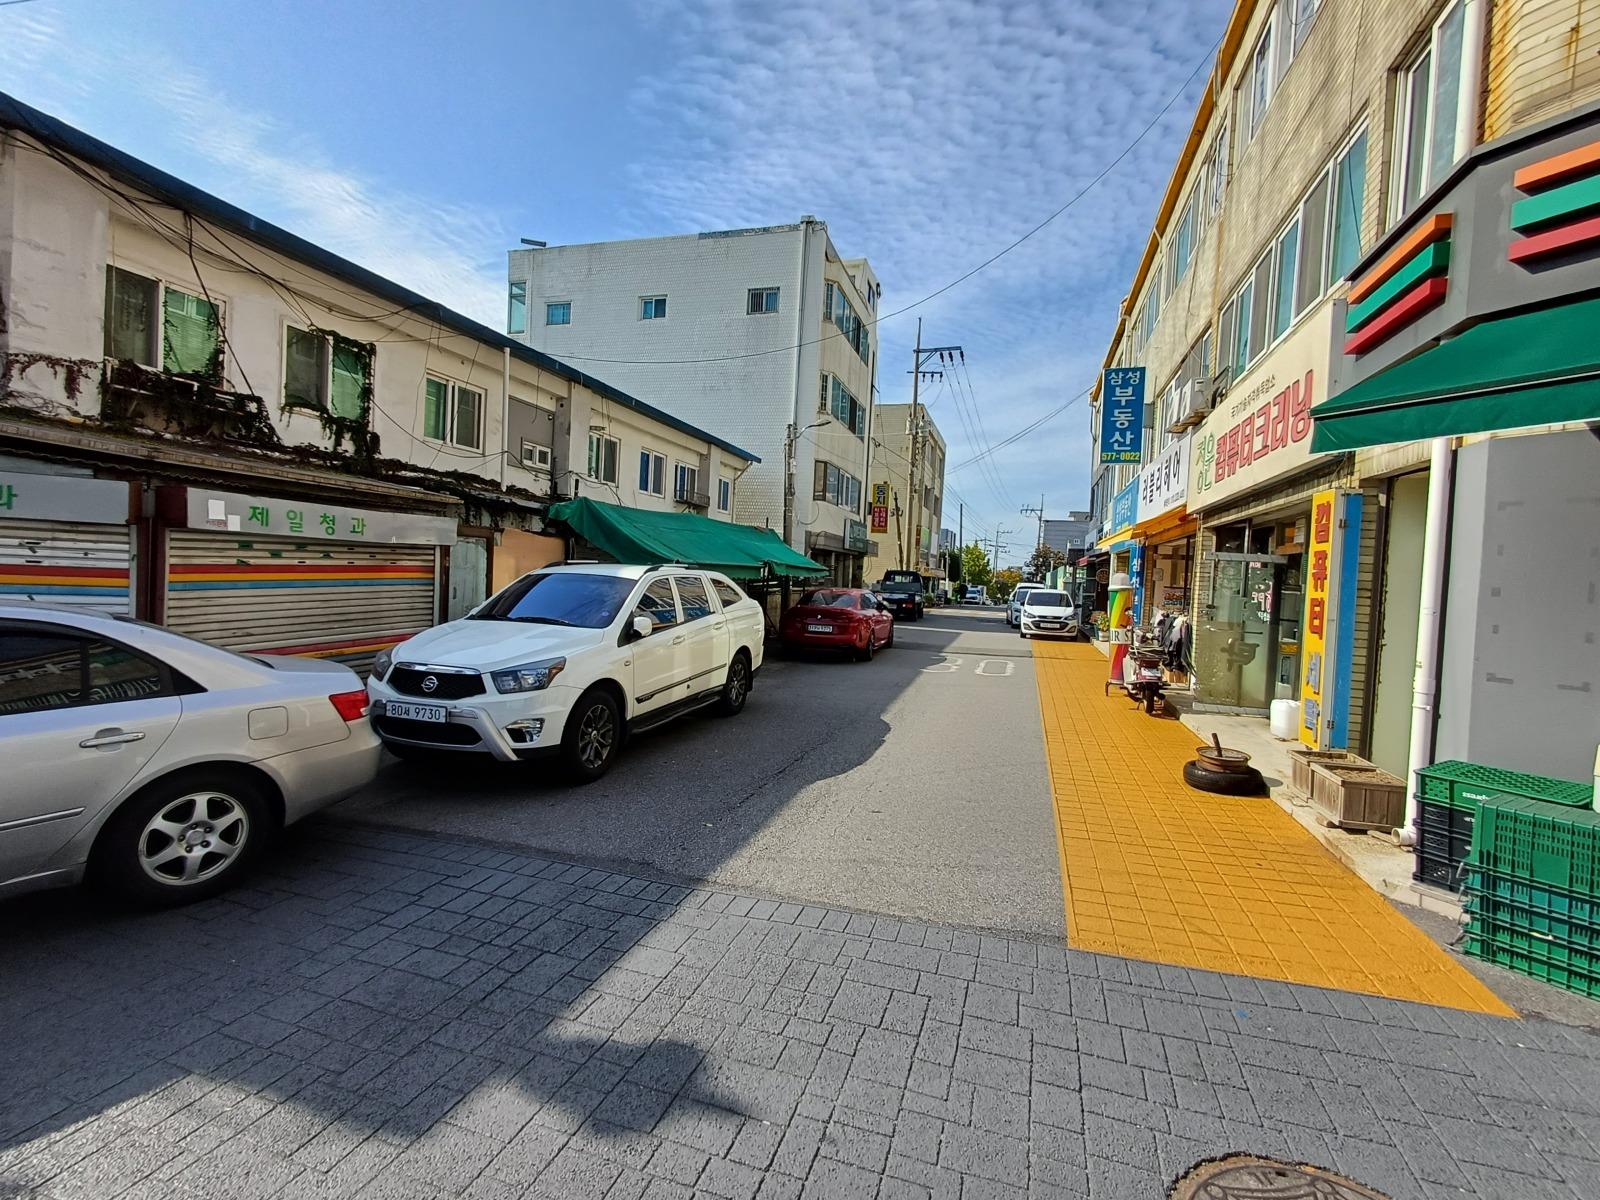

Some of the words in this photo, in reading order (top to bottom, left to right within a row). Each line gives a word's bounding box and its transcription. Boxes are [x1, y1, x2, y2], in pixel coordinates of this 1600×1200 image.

[1108, 371, 1140, 385] 삼성
[1109, 386, 1136, 450] 부동산
[1101, 452, 1140, 461] 577-0022
[1142, 444, 1182, 506] 러블리헤어
[248, 505, 367, 536] 제일청과
[1308, 501, 1332, 641] 컴퓨터
[414, 706, 441, 721] 9730
